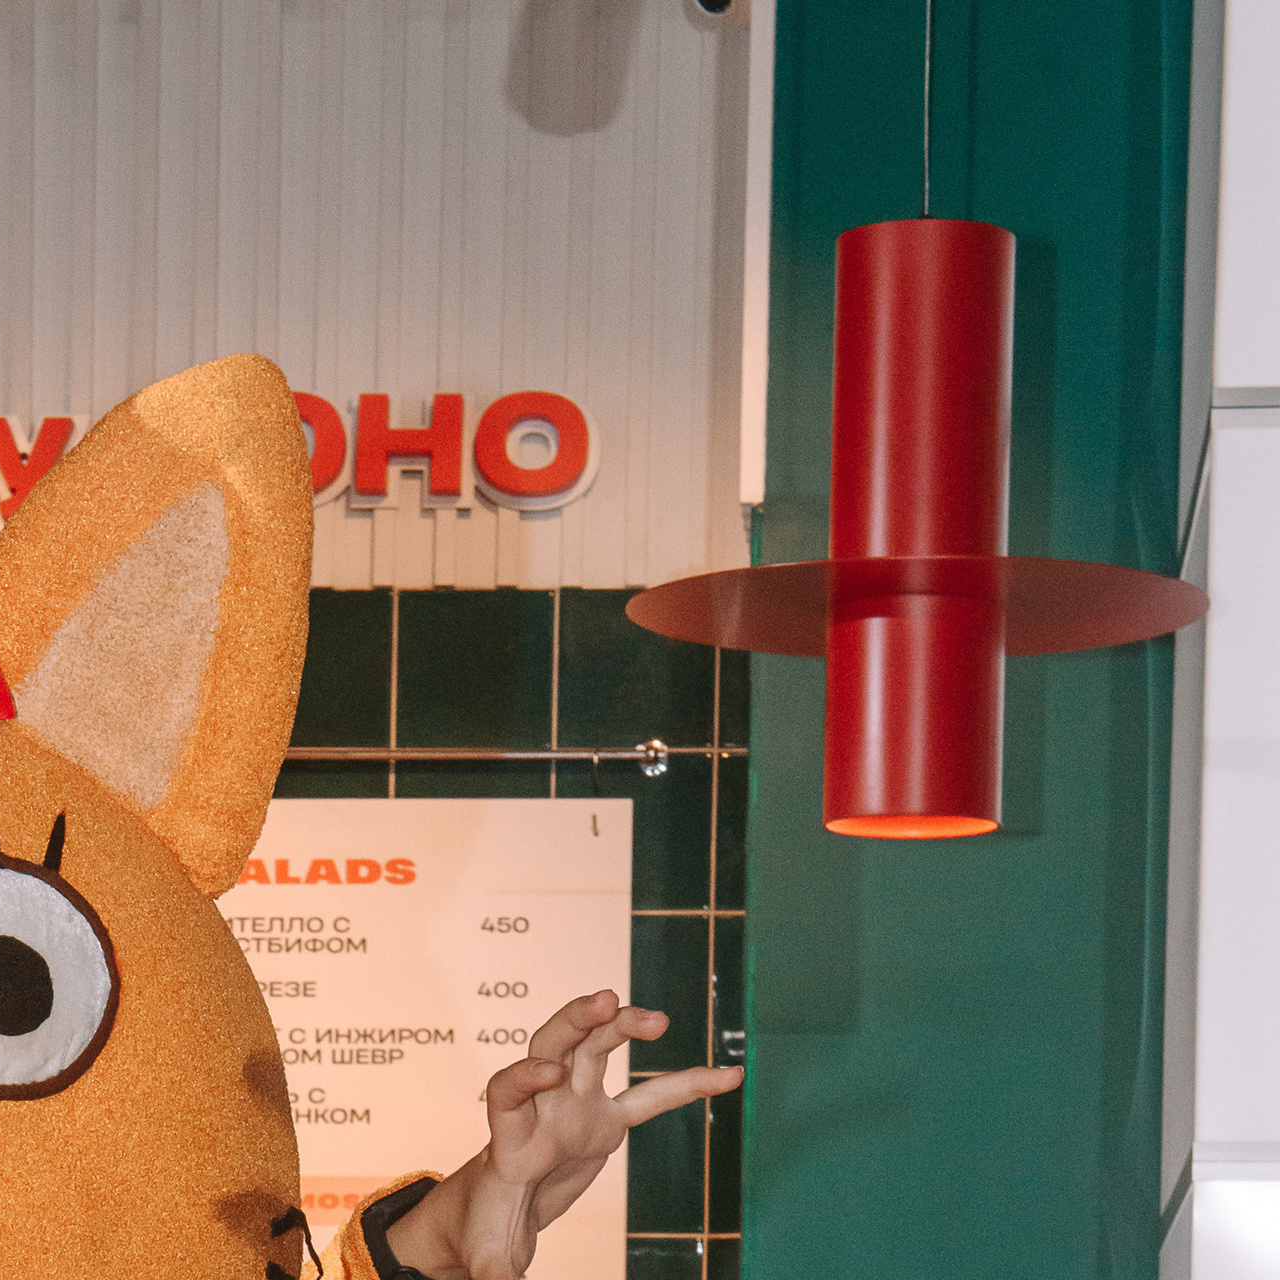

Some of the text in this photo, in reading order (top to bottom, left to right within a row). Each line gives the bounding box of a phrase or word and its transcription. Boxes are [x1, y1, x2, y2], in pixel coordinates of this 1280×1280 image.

[333, 917, 351, 933] С
[480, 916, 530, 934] 450
[477, 981, 529, 998] 400
[289, 1028, 528, 1045] С ИНЖИРОМ 400
[332, 1048, 404, 1065] ШЕВР
